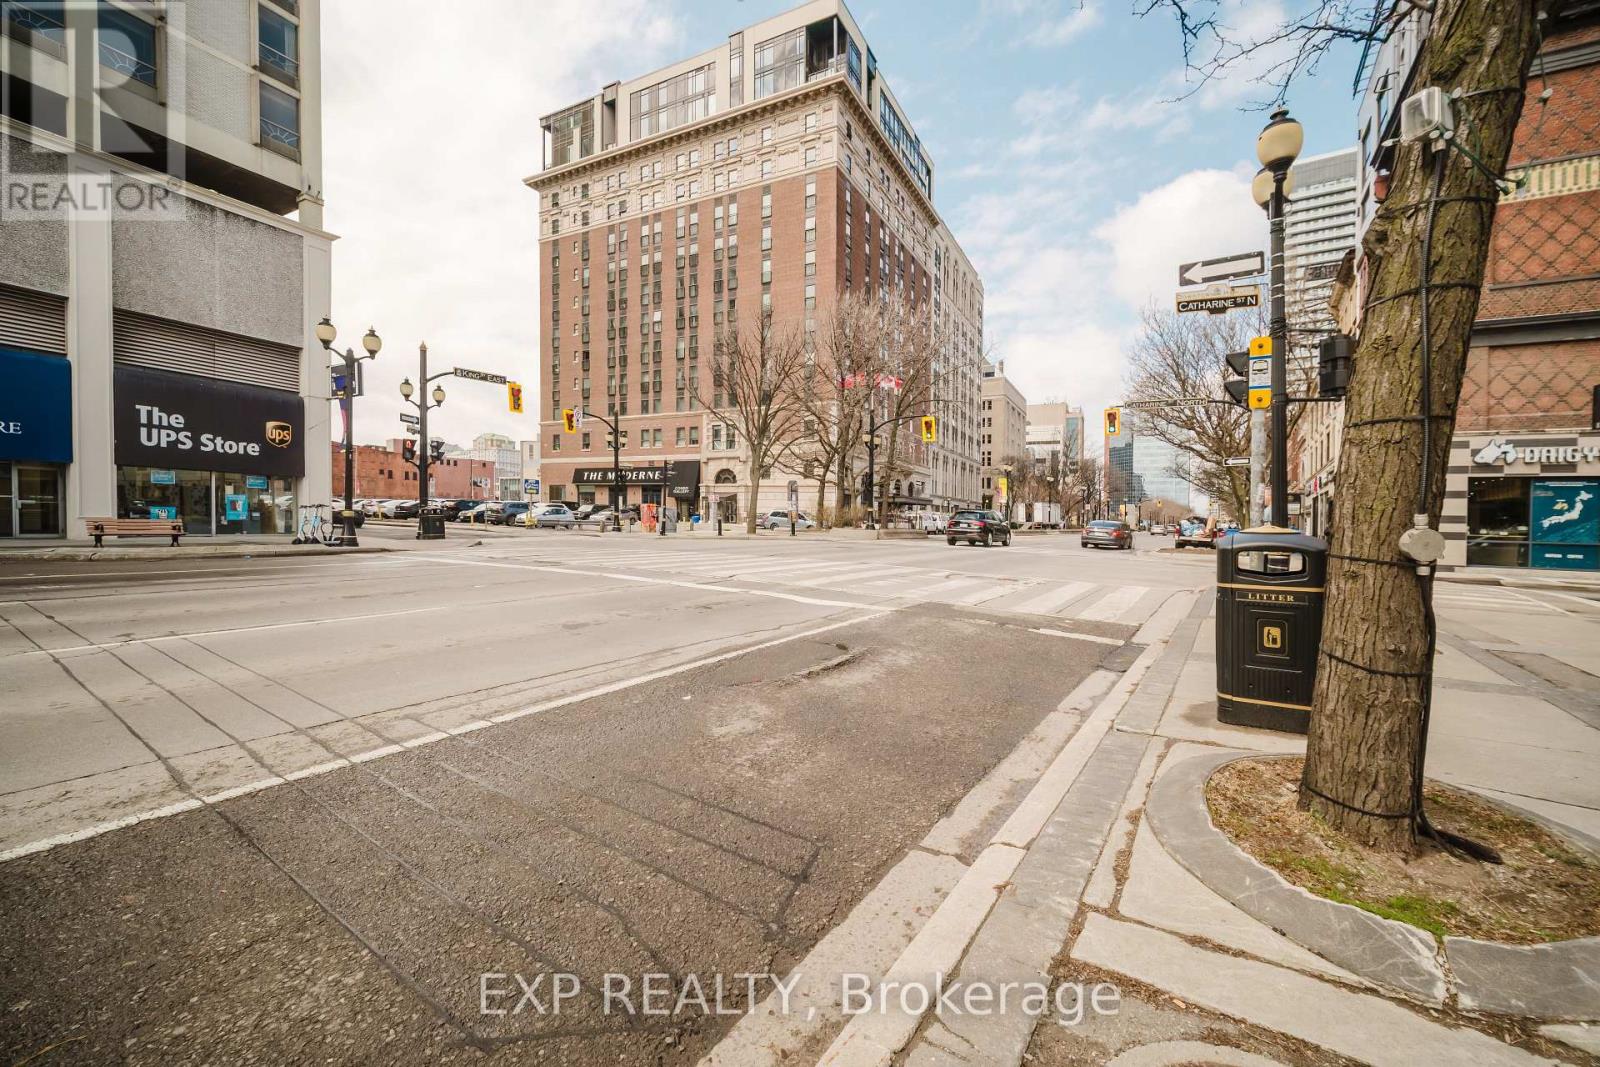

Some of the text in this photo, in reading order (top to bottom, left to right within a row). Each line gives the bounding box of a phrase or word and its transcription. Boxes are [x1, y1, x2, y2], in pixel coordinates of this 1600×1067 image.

[1180, 299, 1235, 311] CATHARINE
[1247, 296, 1256, 305] N
[462, 370, 480, 379] KING
[487, 374, 506, 384] EAST
[135, 404, 185, 428] The
[140, 427, 260, 456] UPS Store
[583, 470, 662, 481] THE MDERNE
[1248, 592, 1295, 602] LITTER
